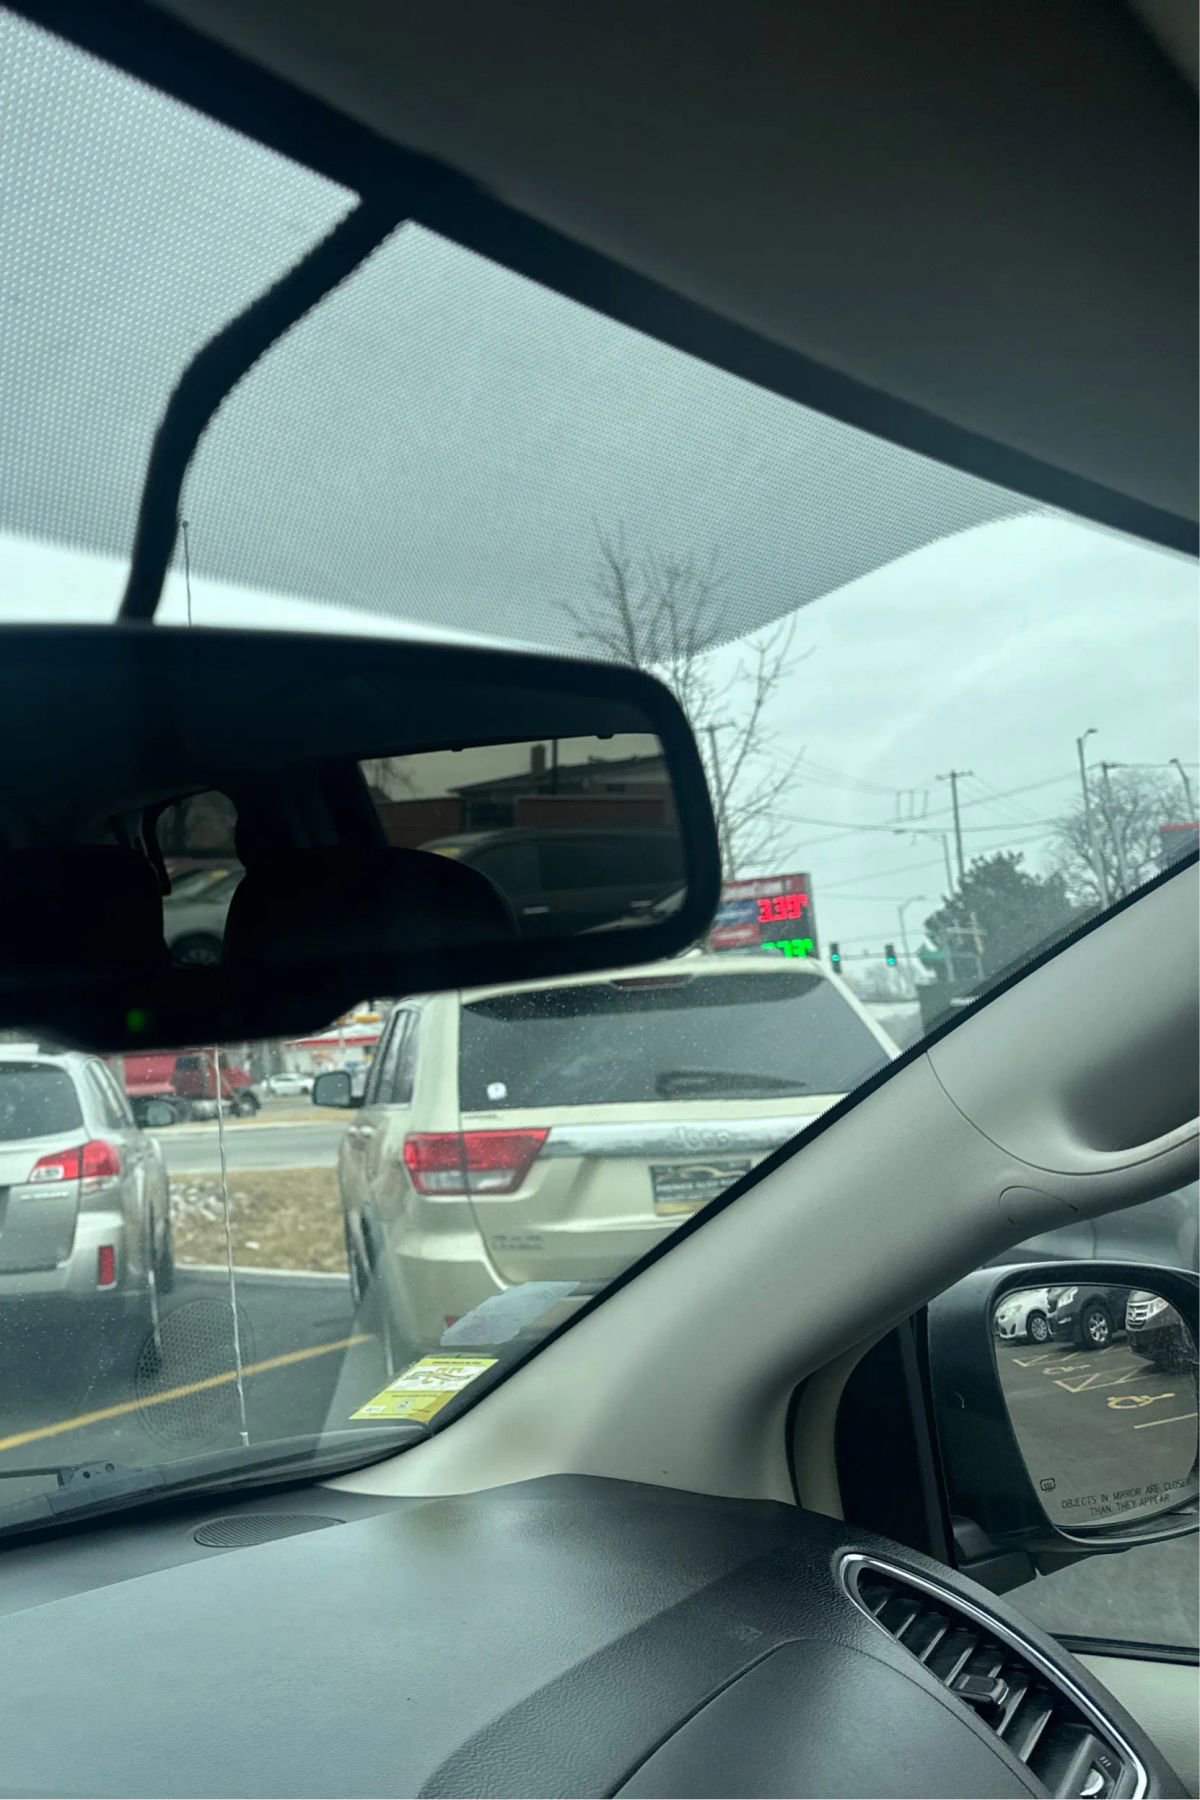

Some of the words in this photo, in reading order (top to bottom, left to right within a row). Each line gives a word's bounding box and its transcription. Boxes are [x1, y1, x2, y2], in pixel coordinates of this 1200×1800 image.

[1061, 1495, 1097, 1509] OBJECTS
[1100, 1493, 1109, 1503] IN
[1113, 1488, 1141, 1500] MIRROR
[1146, 1483, 1160, 1494] ARE
[1088, 1506, 1112, 1516] THAN
[1115, 1500, 1136, 1512] THEY
[1139, 1493, 1170, 1506] APPEAR
